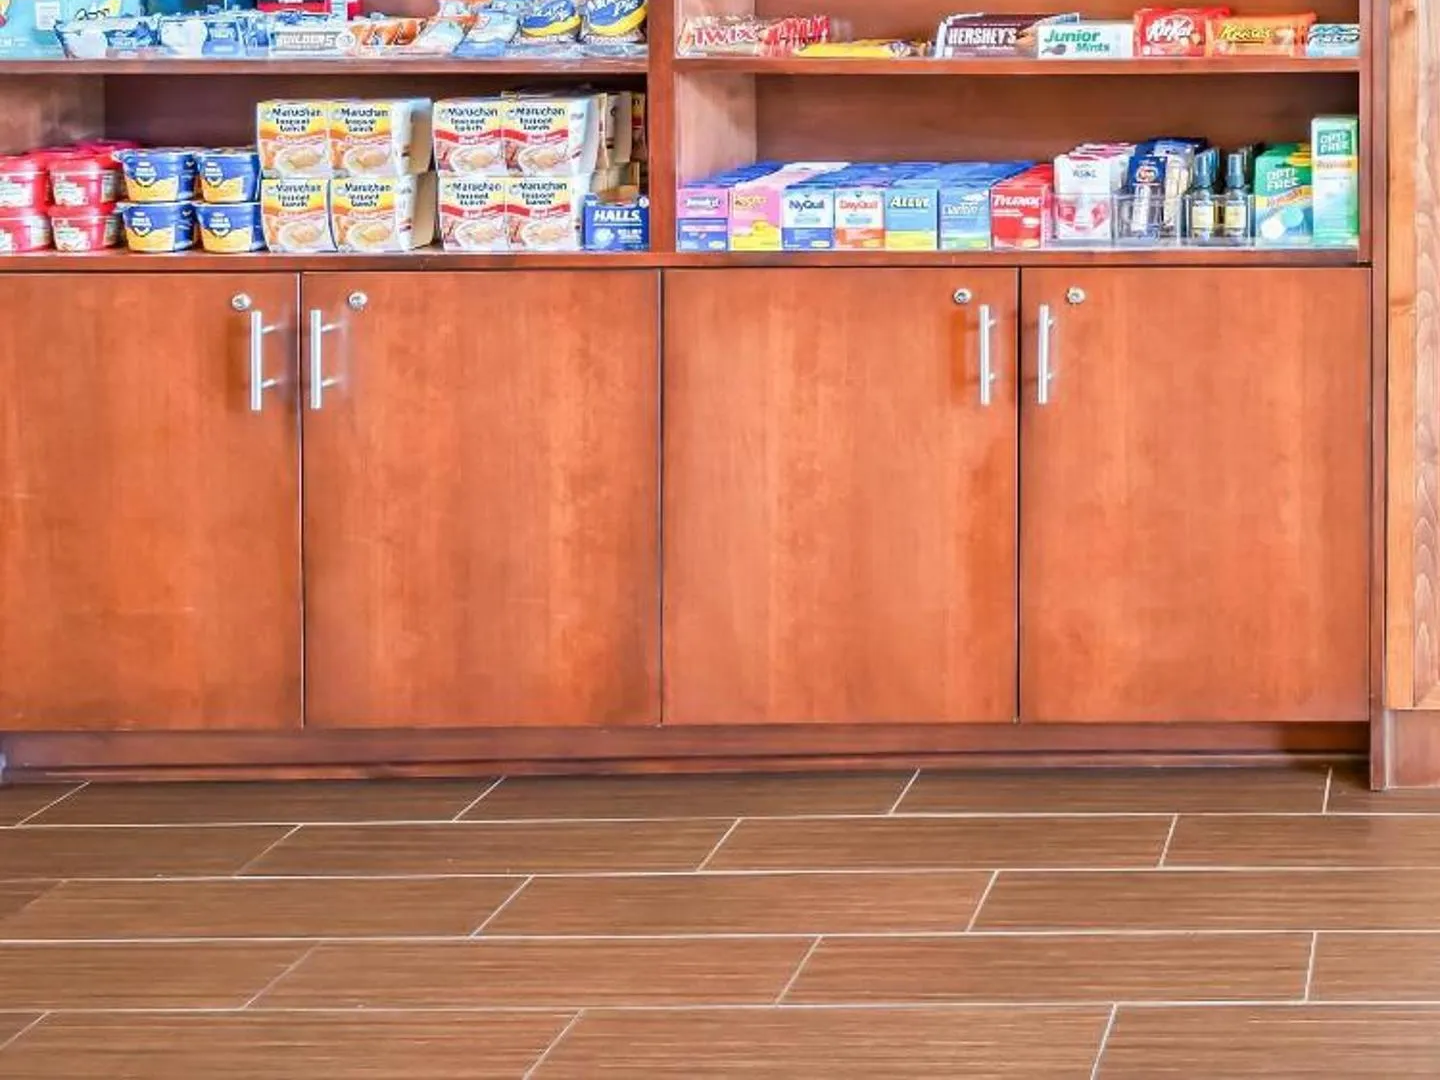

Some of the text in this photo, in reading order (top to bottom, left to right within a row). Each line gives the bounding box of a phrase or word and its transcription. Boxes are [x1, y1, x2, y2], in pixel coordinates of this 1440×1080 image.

[949, 27, 1017, 45] HERSHEY'S
[1044, 29, 1101, 43] Junior
[1077, 42, 1110, 52] Mints
[448, 107, 498, 117] Maruchan
[515, 107, 565, 117] Maruchan
[518, 182, 567, 191] Maruchan
[594, 210, 641, 222] HALLS
